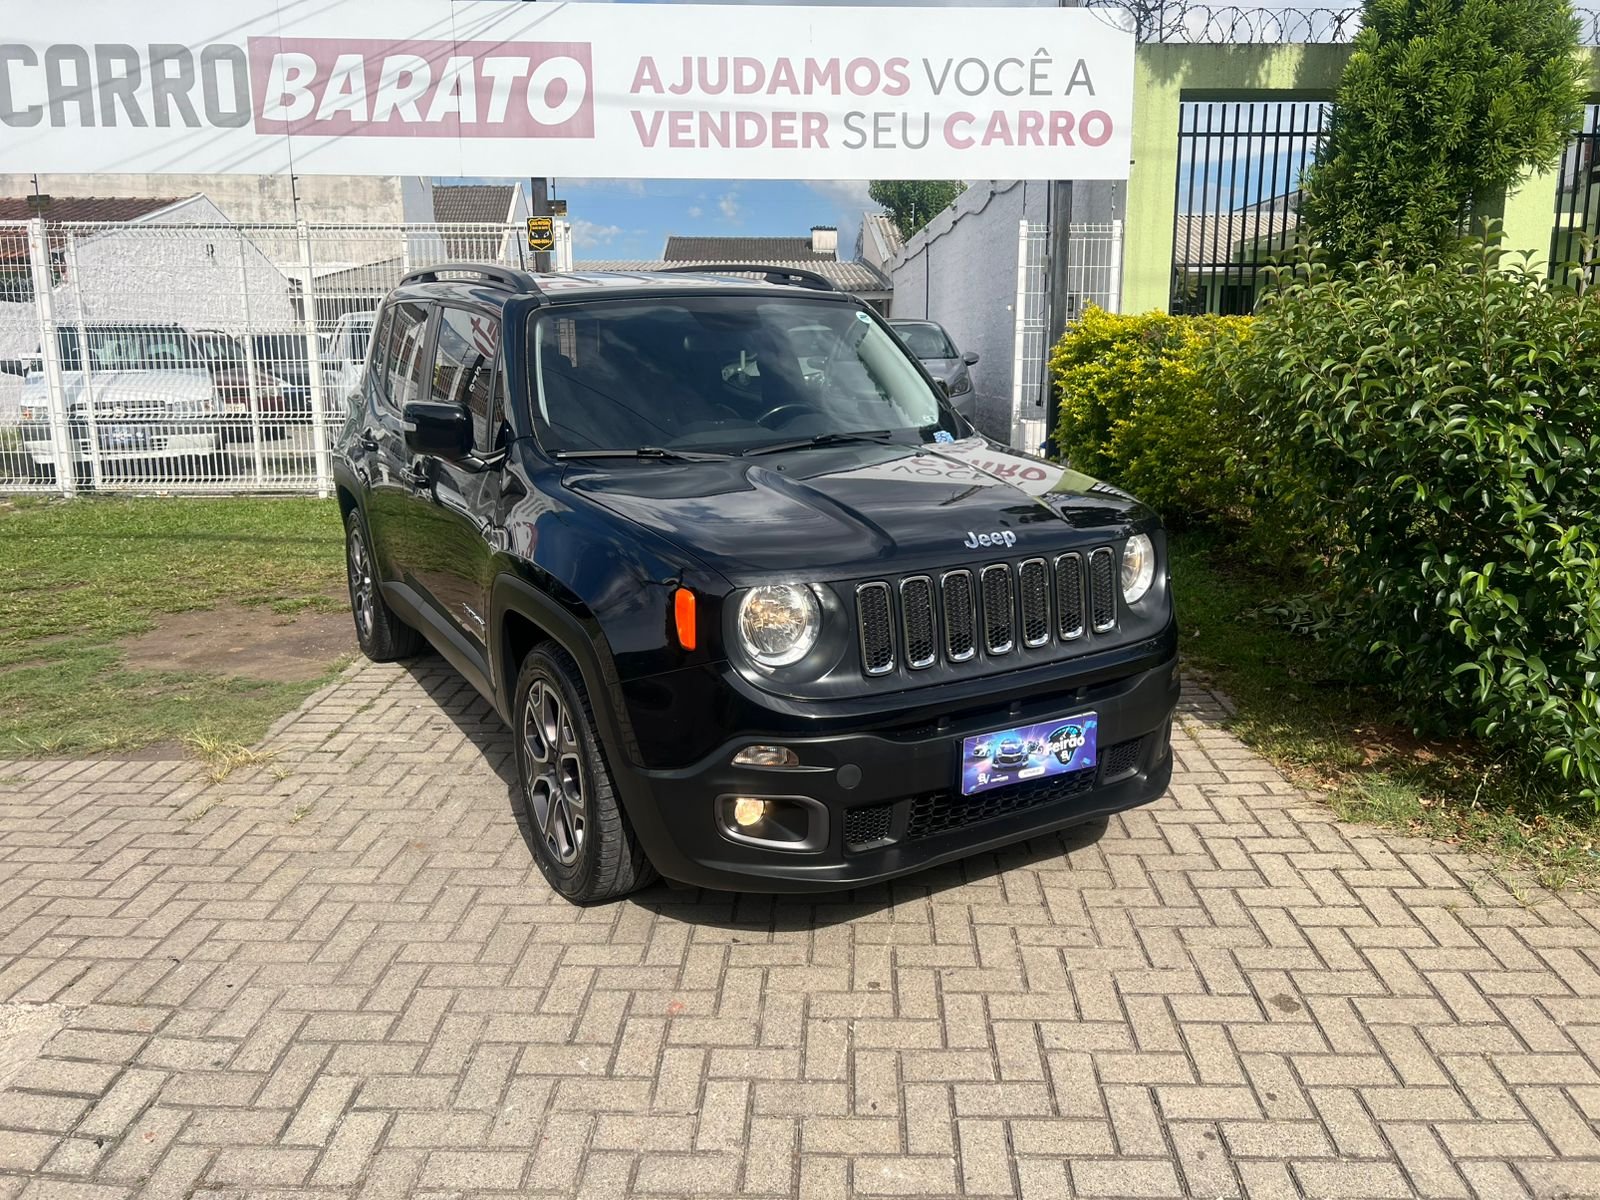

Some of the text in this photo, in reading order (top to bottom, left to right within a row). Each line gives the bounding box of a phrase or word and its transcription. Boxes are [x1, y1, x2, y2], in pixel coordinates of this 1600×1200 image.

[0, 43, 587, 128] CARRO BARATO
[629, 47, 1096, 97] AJUDAMOS VOCÊ A
[630, 109, 1113, 150] VENDER SEU CARRO
[963, 530, 1017, 549] Jeep
